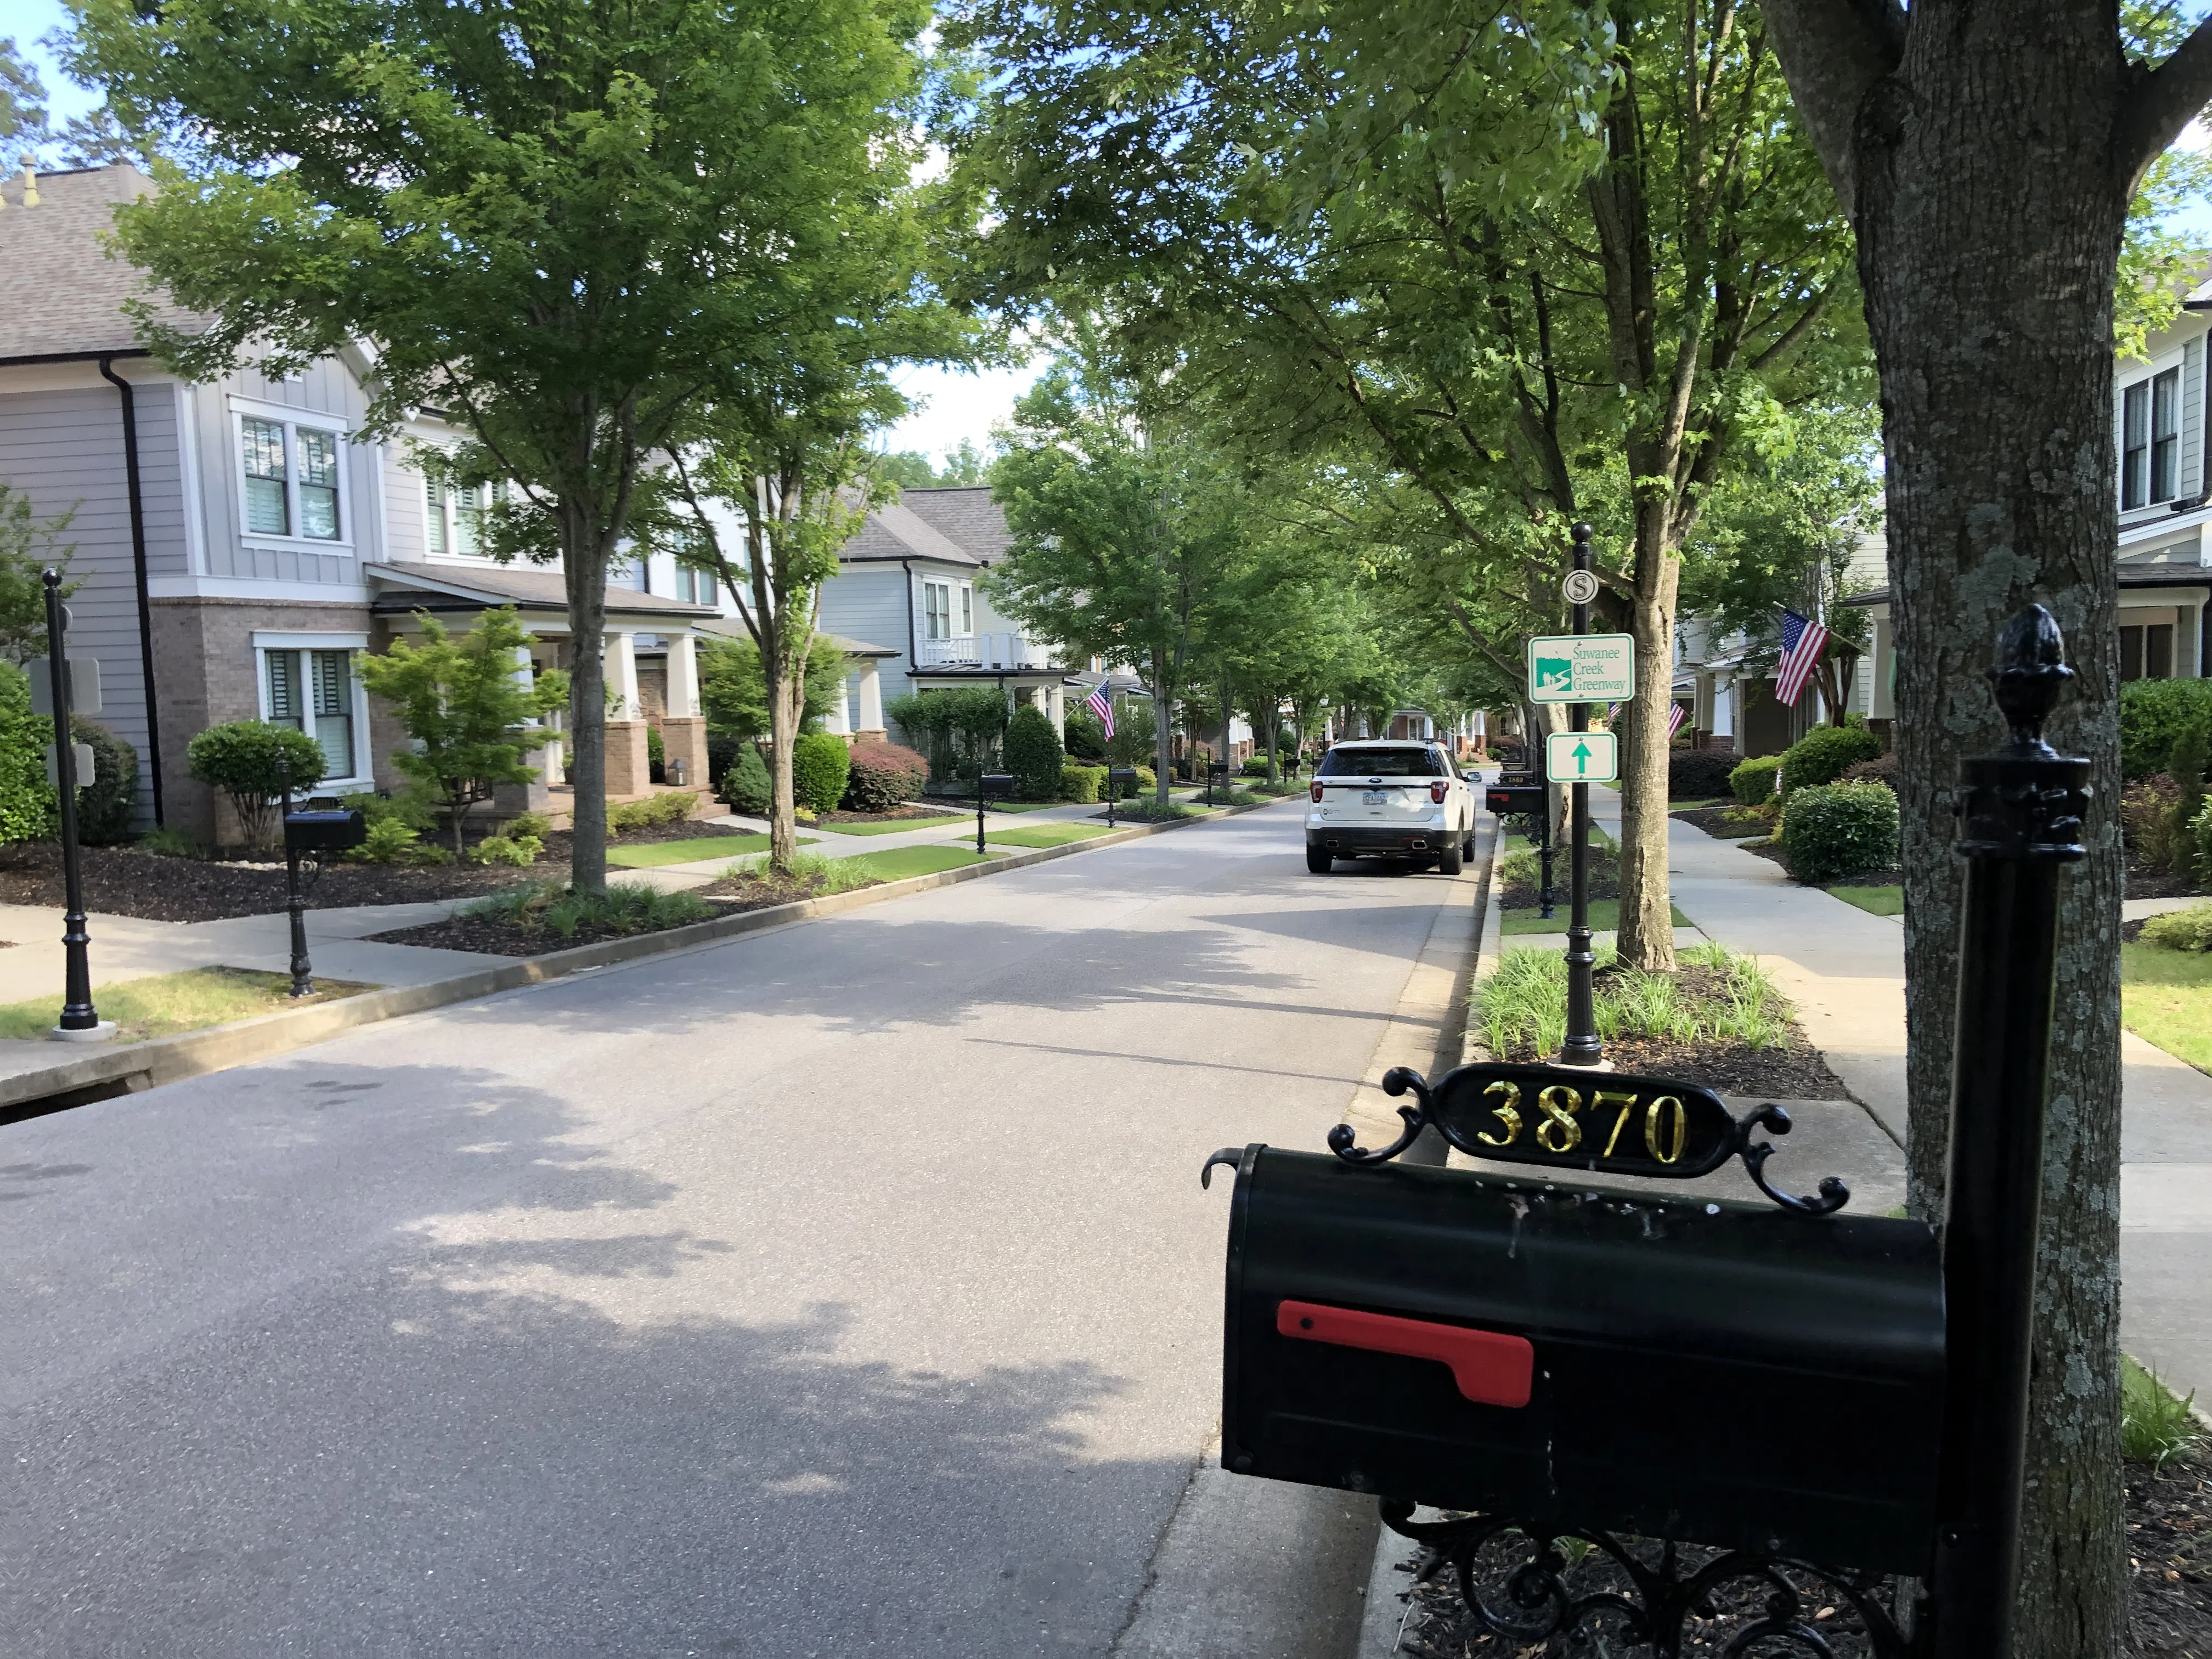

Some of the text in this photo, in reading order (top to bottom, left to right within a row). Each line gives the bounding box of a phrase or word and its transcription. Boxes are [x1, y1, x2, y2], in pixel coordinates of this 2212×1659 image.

[1573, 576, 1587, 597] S
[1573, 647, 1620, 659] Suwanee
[1573, 661, 1604, 675] Creek
[1573, 678, 1626, 693] Greenway
[1477, 1081, 1685, 1164] 3870
